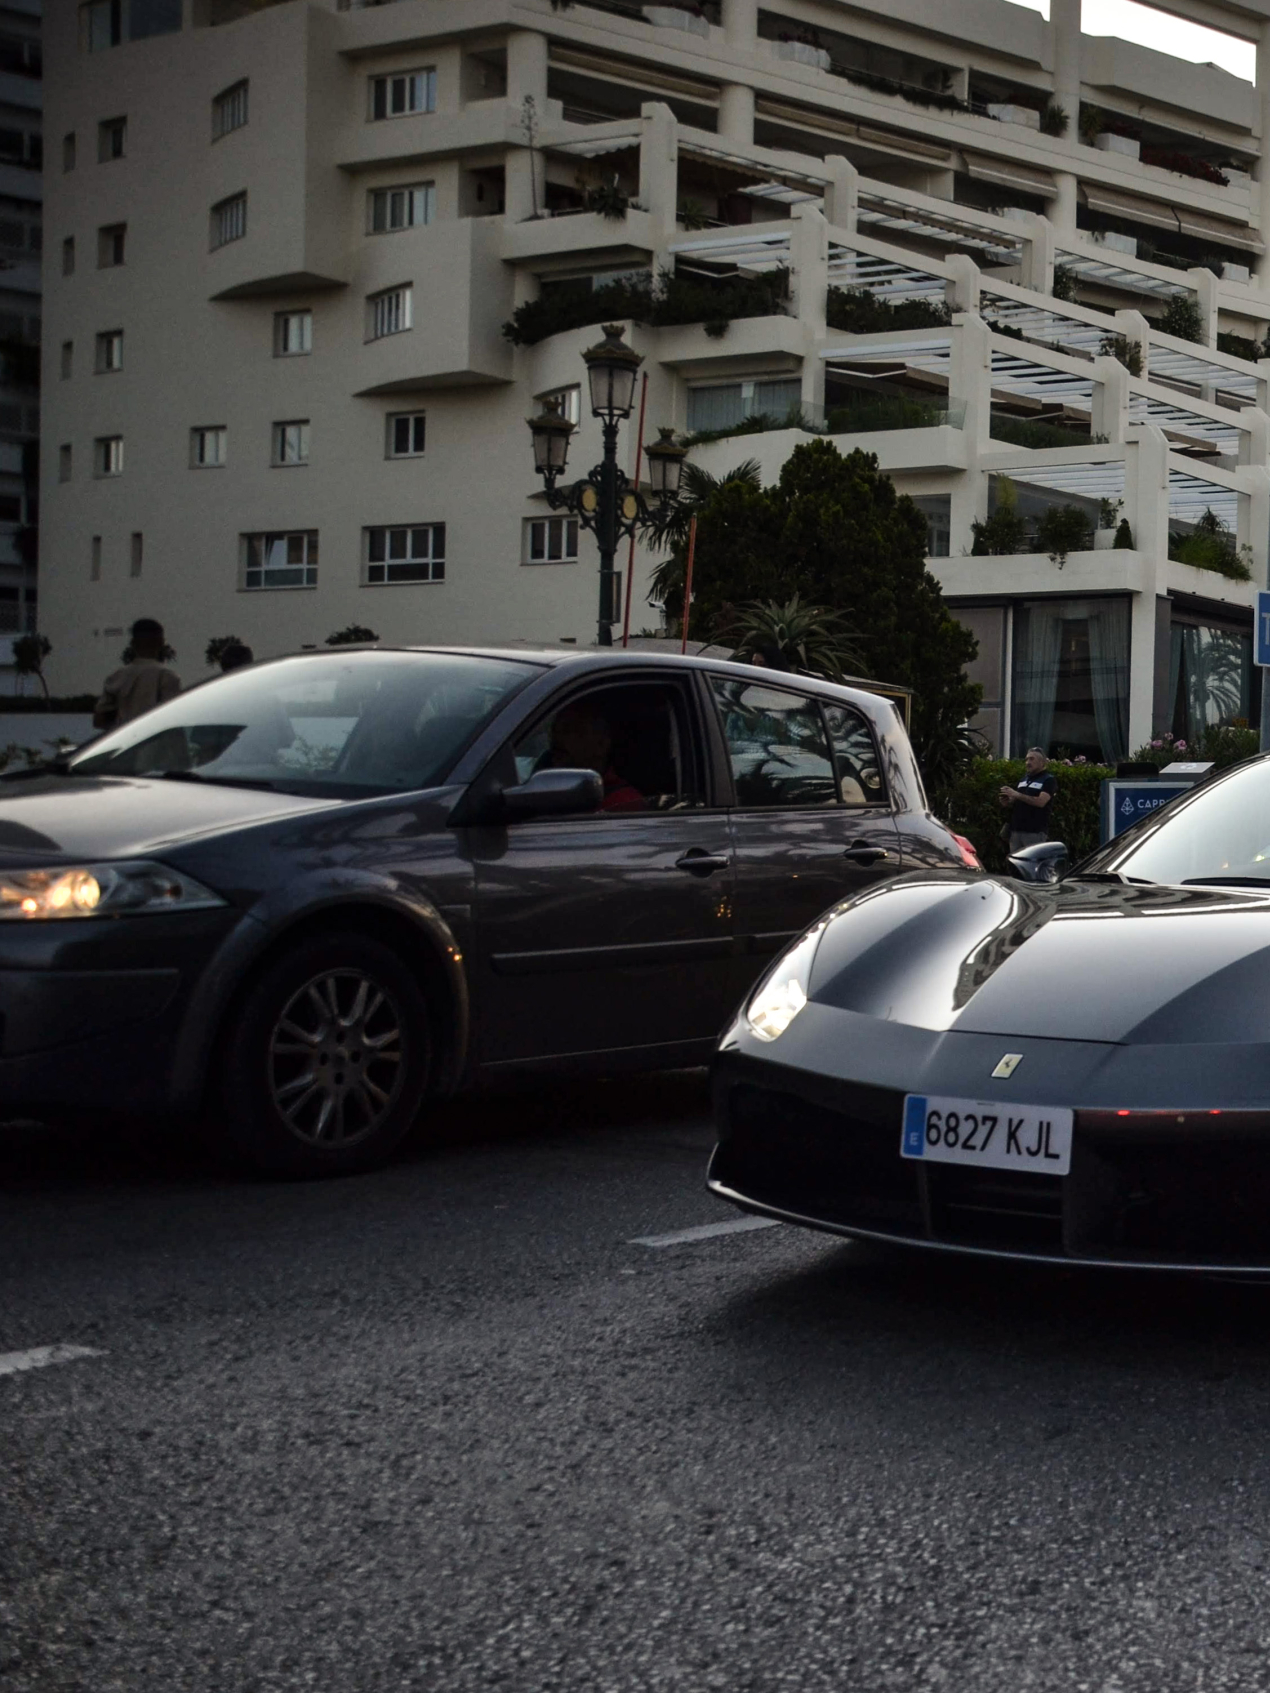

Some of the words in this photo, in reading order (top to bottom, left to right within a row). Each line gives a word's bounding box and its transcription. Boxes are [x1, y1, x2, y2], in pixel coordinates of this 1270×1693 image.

[909, 1132, 920, 1146] E
[925, 1110, 998, 1152] 6827
[1006, 1117, 1060, 1160] KJL
